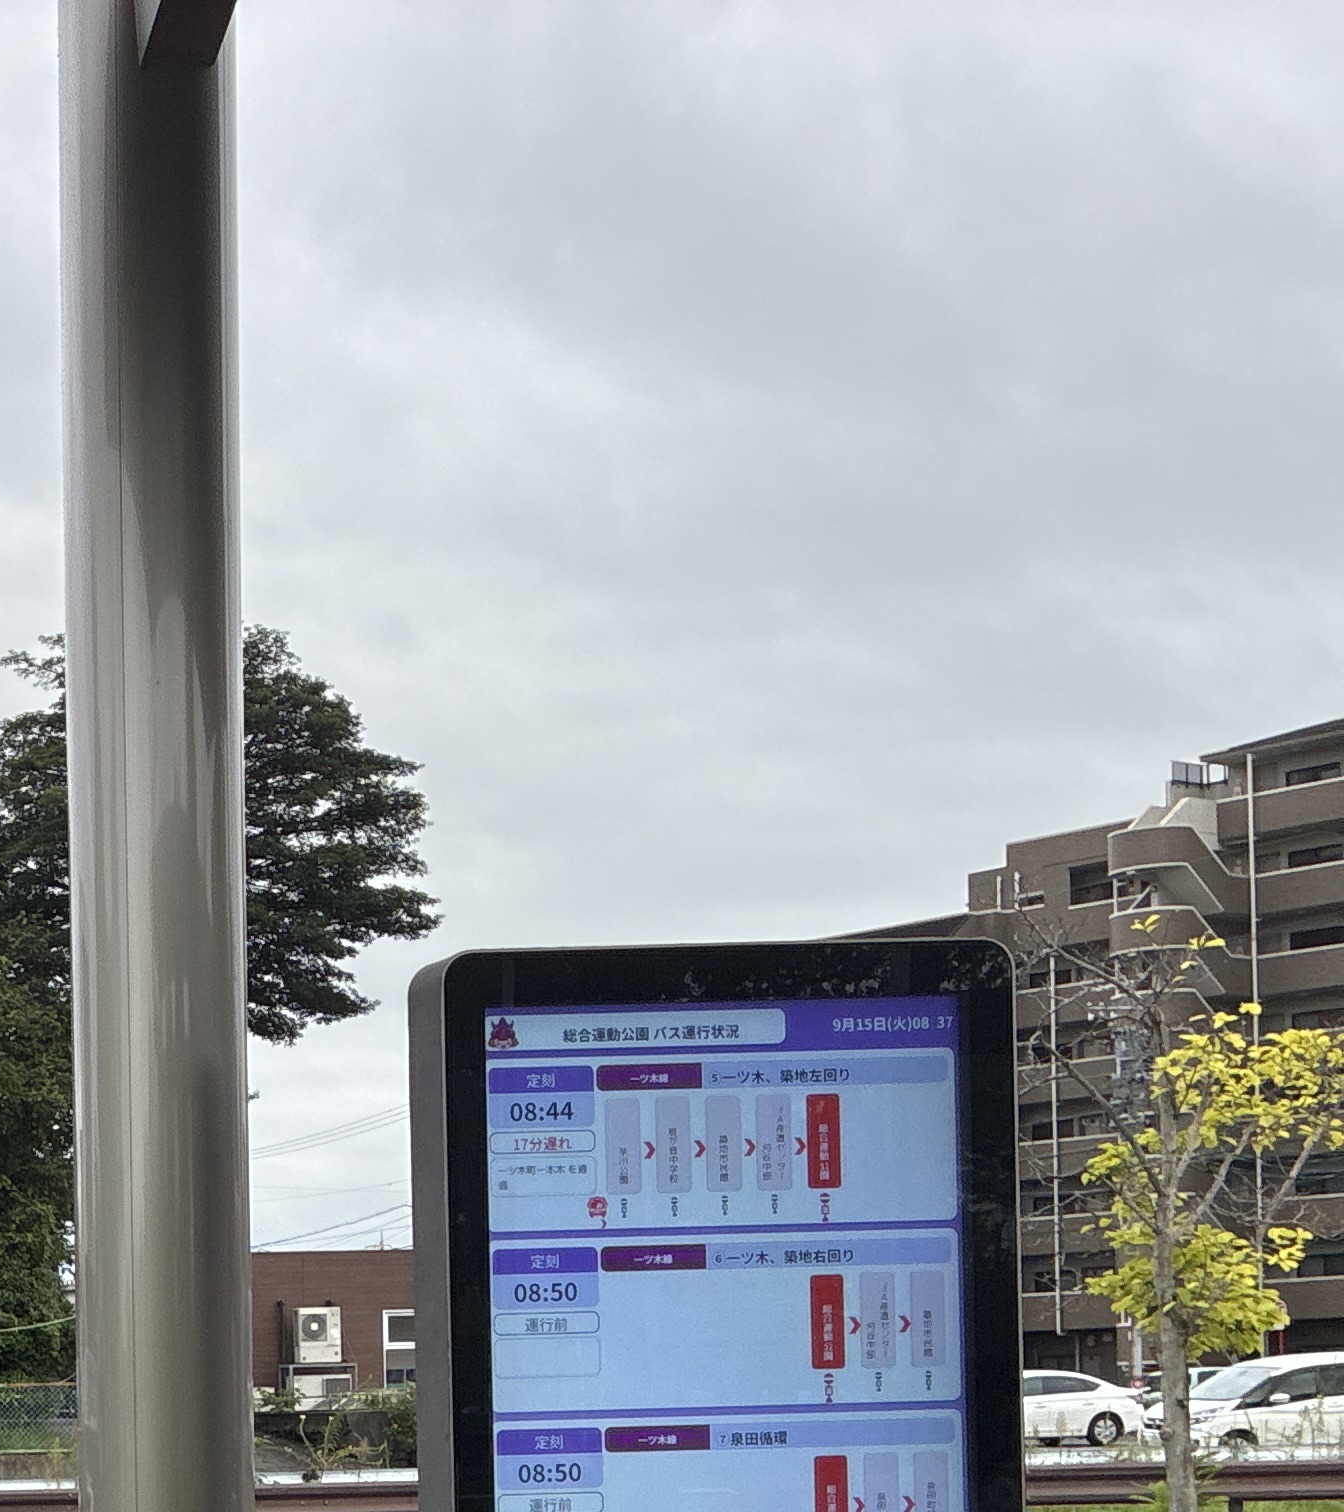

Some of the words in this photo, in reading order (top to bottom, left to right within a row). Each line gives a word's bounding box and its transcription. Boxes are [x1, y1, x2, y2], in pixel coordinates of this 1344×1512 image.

[937, 1015, 954, 1029] 37
[563, 1027, 649, 1044] 総合運動公園
[653, 1024, 740, 1041] バス運行状況
[526, 1072, 556, 1089] 定刻
[629, 1073, 669, 1084] 一ツ木線
[510, 1101, 573, 1122] 08:44
[513, 1136, 572, 1151] 17分遅れ
[818, 1123, 830, 1181] 総合運動公園
[530, 1254, 560, 1269] 定刻
[634, 1255, 673, 1265] 一ツ木線
[514, 1282, 578, 1303] 08:50
[525, 1317, 568, 1333] 運行前
[822, 1304, 834, 1361] 総合運動公園
[534, 1434, 564, 1450] 定刻
[637, 1435, 677, 1446] 一ツ木線
[518, 1462, 582, 1483] 08:50
[529, 1498, 572, 1512] 運行前
